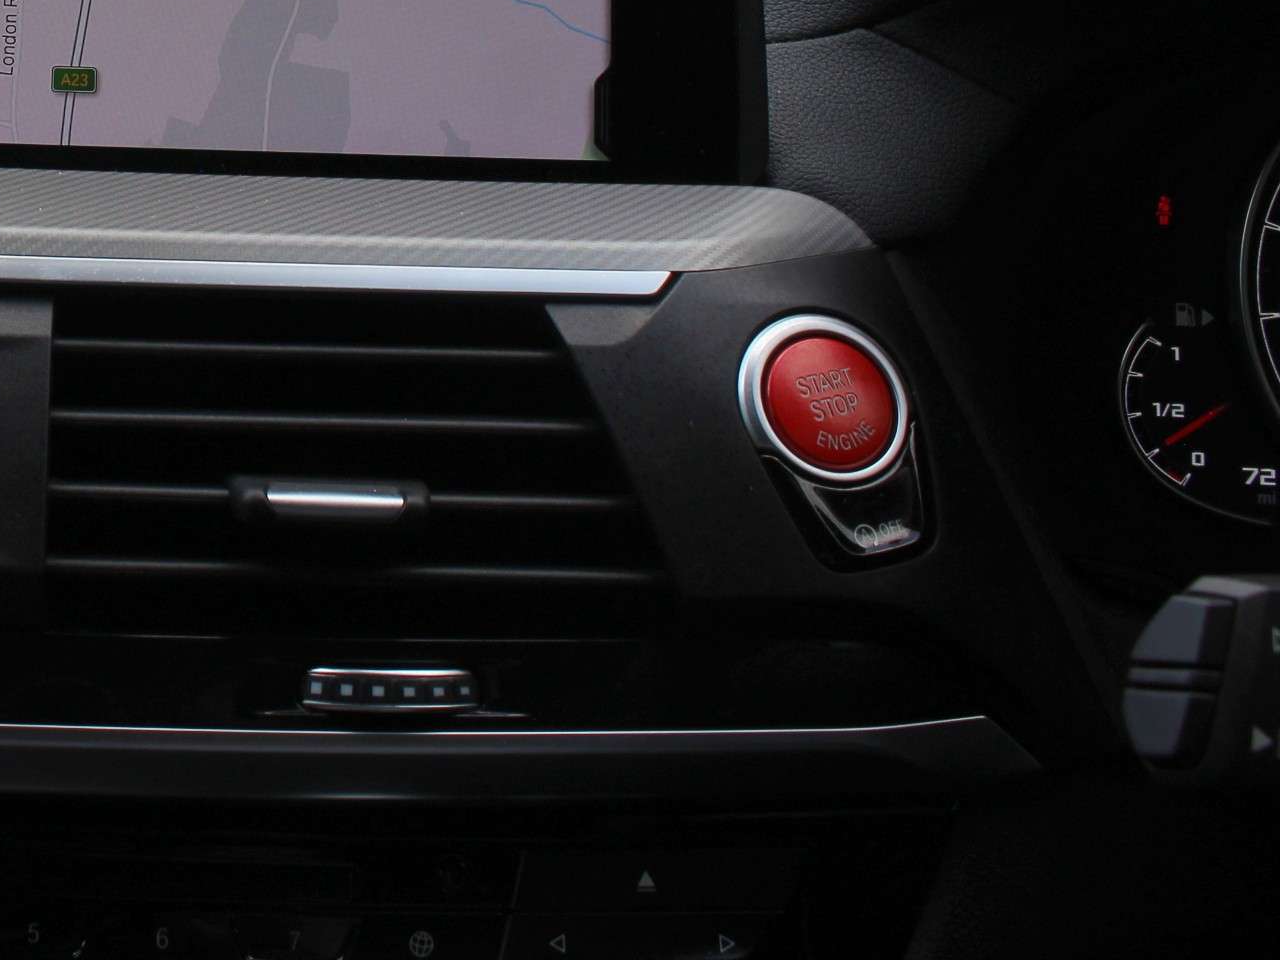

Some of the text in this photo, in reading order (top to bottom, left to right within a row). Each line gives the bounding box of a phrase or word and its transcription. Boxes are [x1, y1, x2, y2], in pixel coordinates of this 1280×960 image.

[0, 13, 18, 76] London
[60, 72, 89, 87] A23
[1171, 346, 1181, 361] 1
[795, 368, 855, 398] START
[810, 393, 859, 422] STOP
[1152, 402, 1185, 418] 1/2
[816, 420, 876, 451] ENGINE
[27, 922, 40, 944] 5
[155, 927, 169, 949] 6
